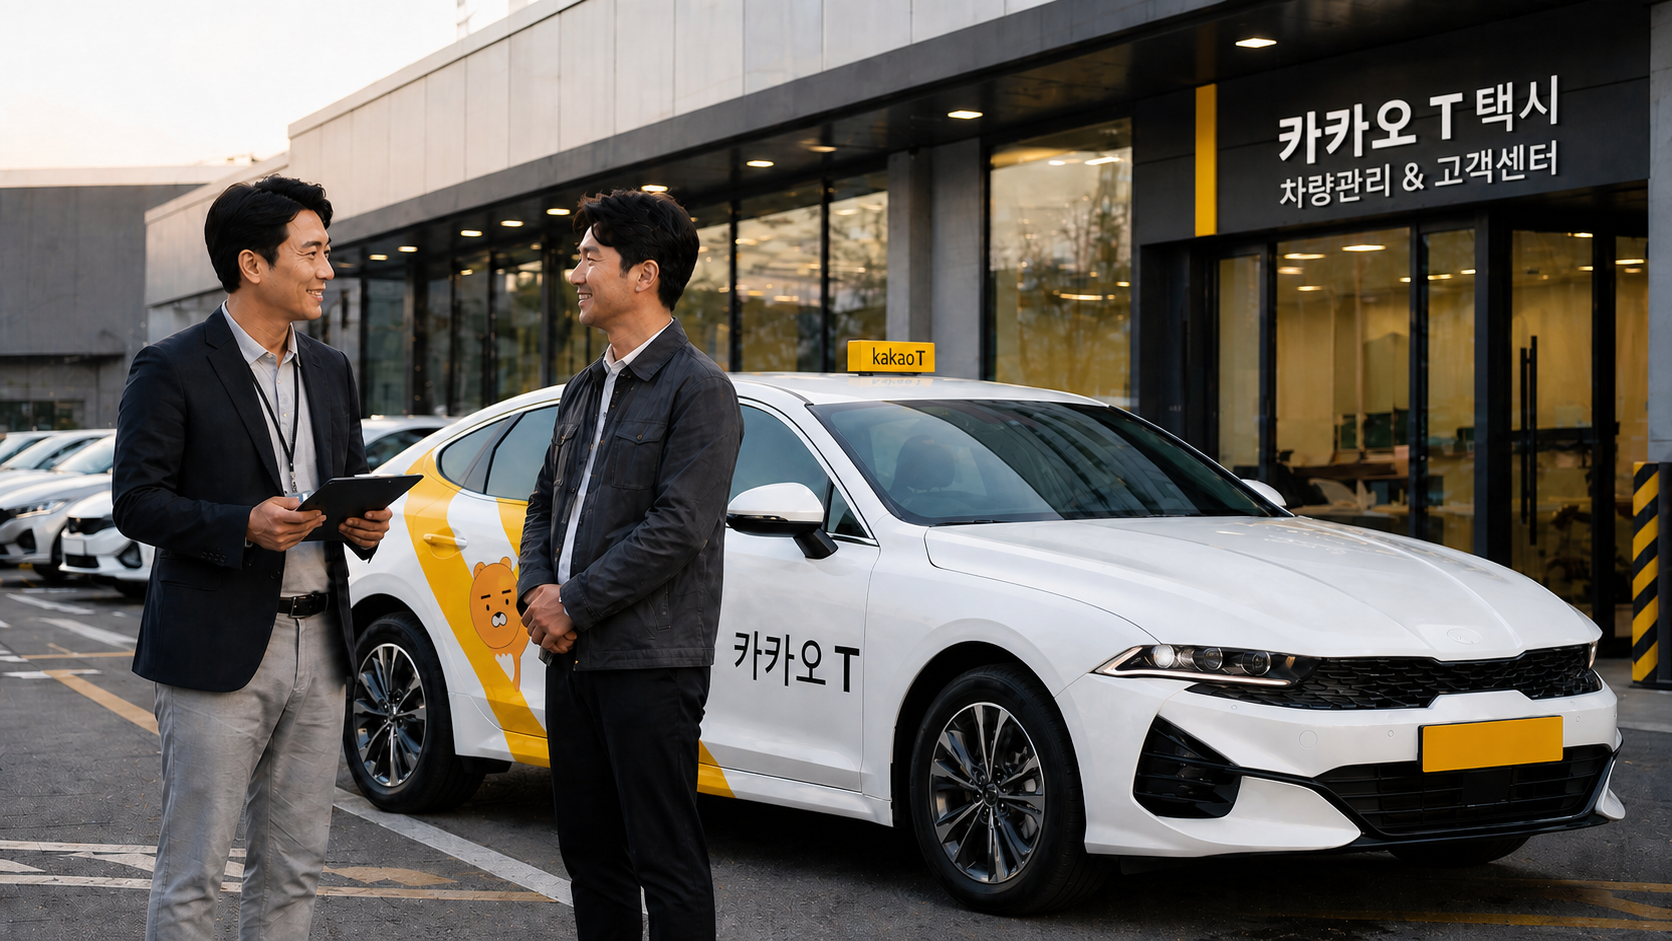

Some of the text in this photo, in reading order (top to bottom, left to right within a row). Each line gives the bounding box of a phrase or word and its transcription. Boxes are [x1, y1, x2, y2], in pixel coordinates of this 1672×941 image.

[1278, 74, 1559, 164] 카카오 T 택시
[1279, 139, 1558, 209] 차량관리 & 고객센터
[734, 630, 860, 693] 카카오 T
